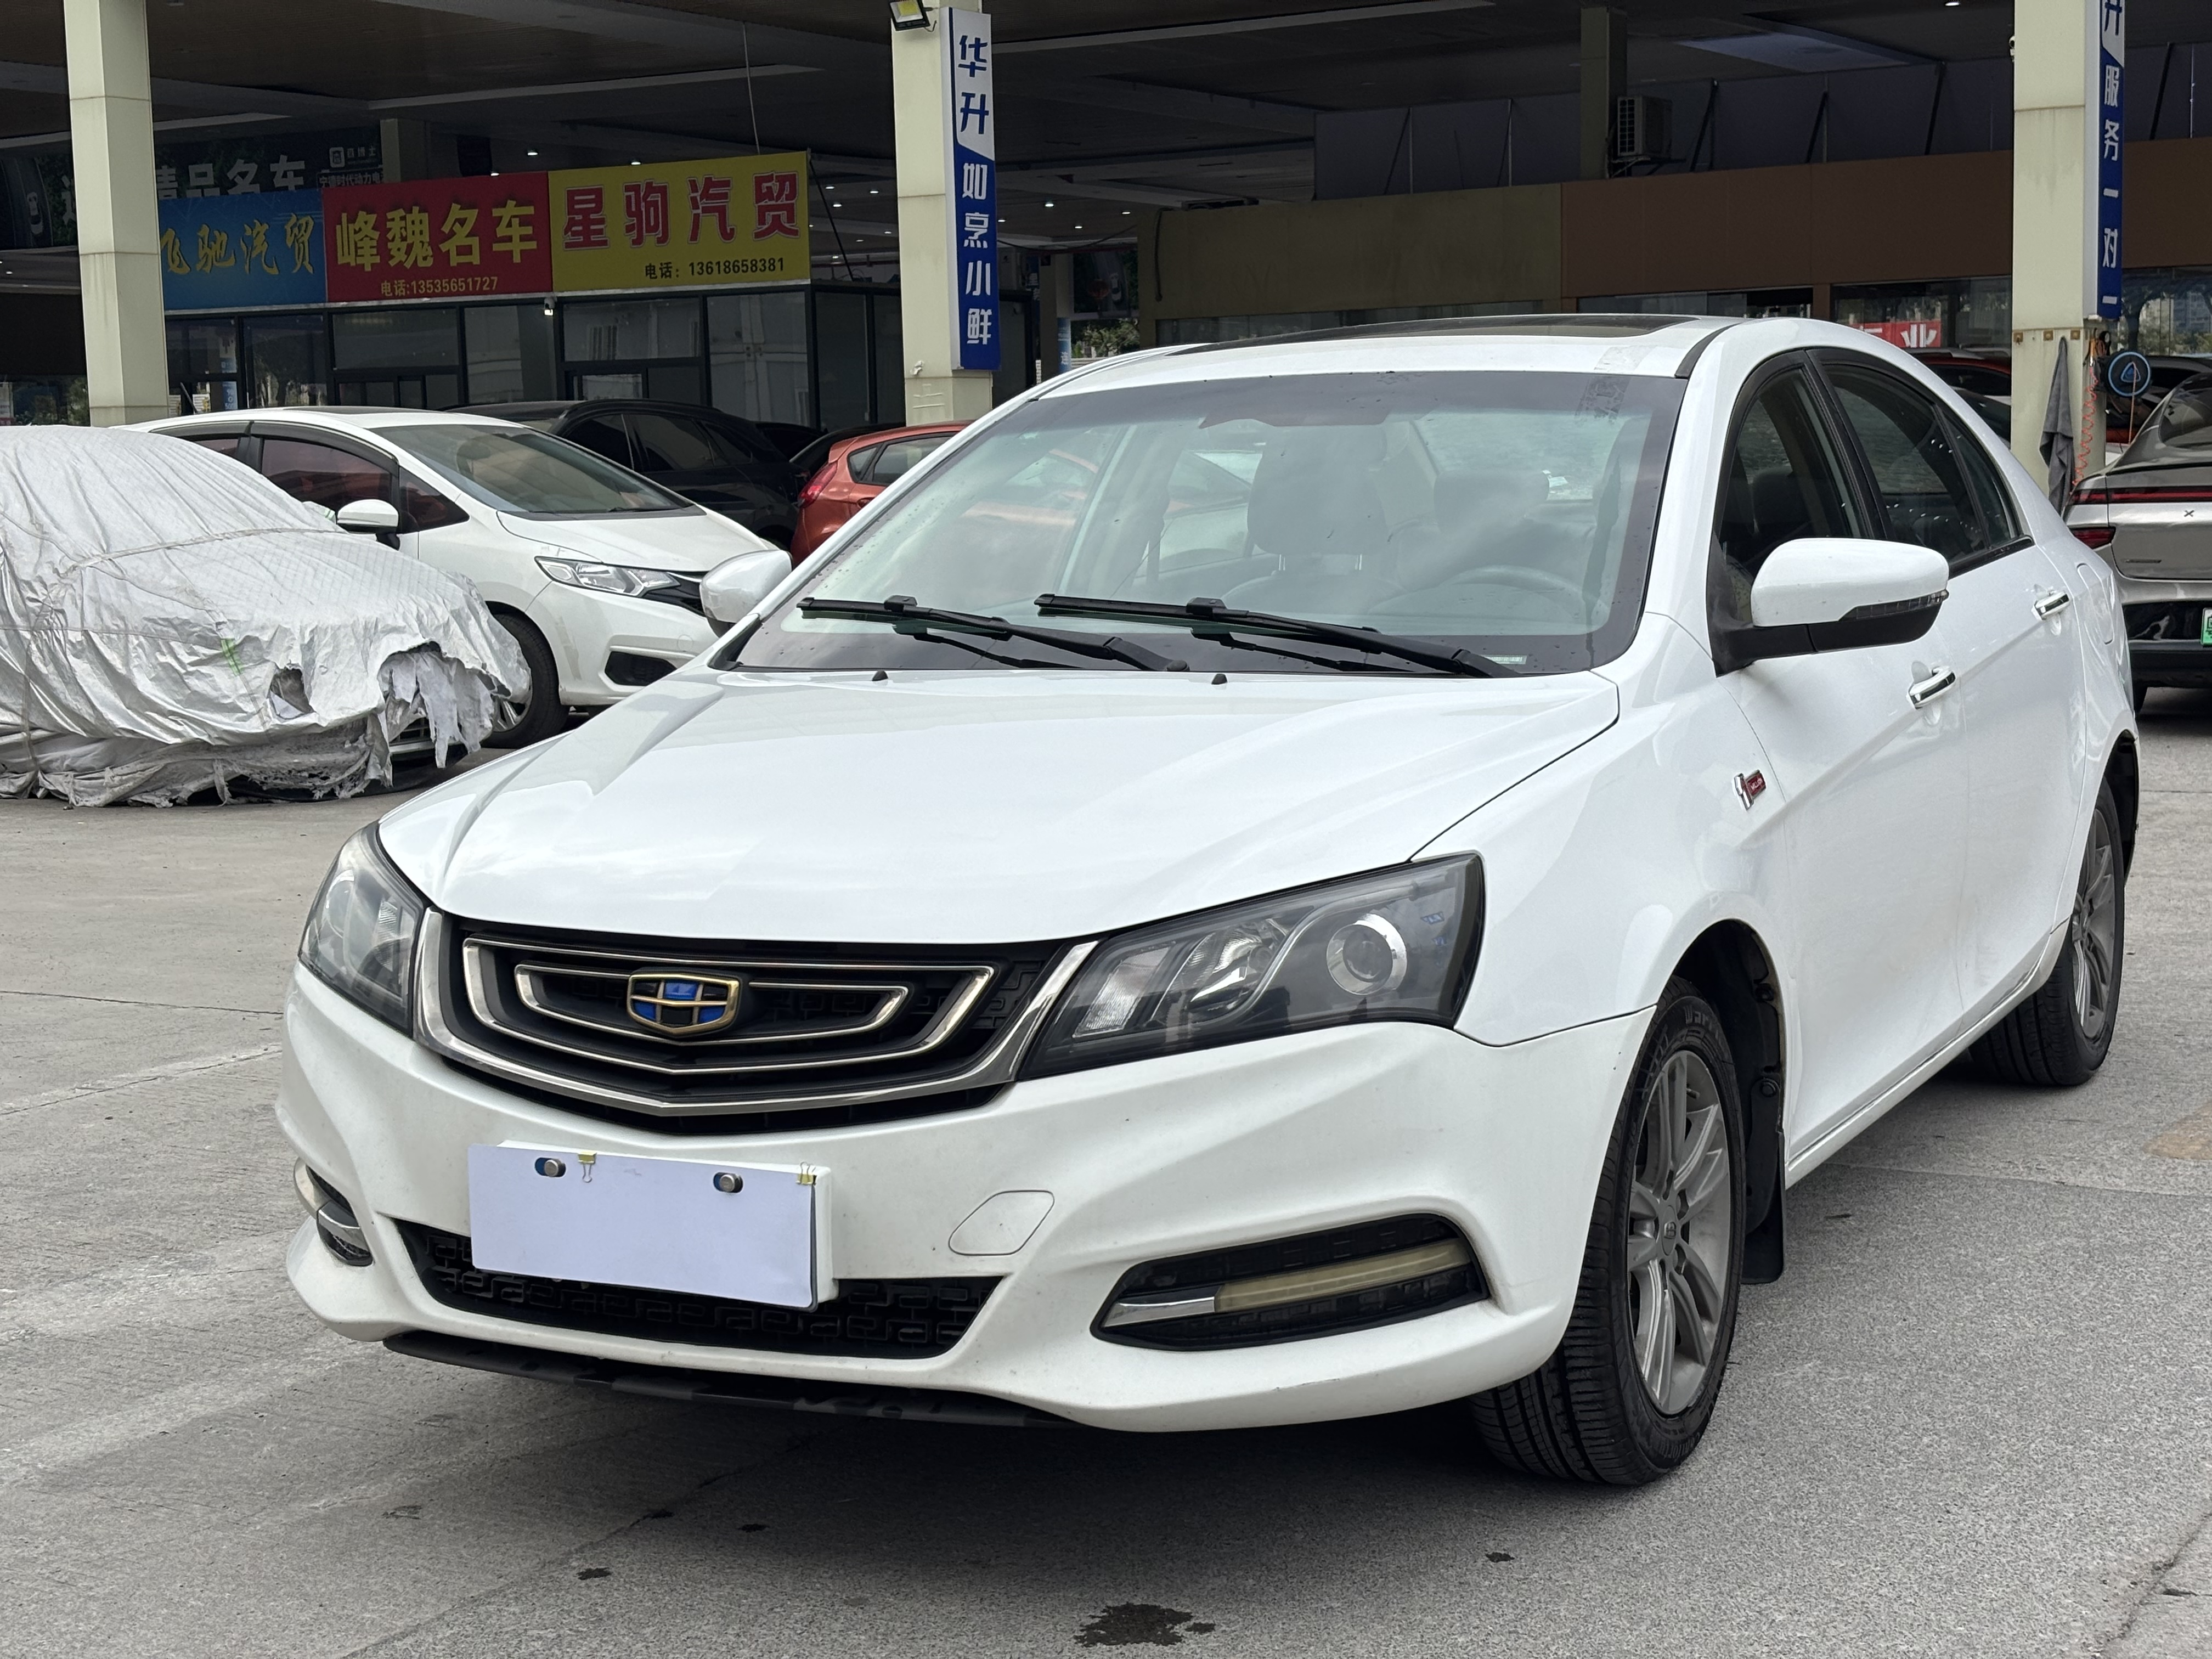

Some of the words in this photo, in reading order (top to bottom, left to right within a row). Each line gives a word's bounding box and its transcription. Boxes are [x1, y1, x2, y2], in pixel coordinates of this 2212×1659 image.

[335, 199, 537, 272] 峰魏名车
[562, 171, 800, 251] 星驹汽贸
